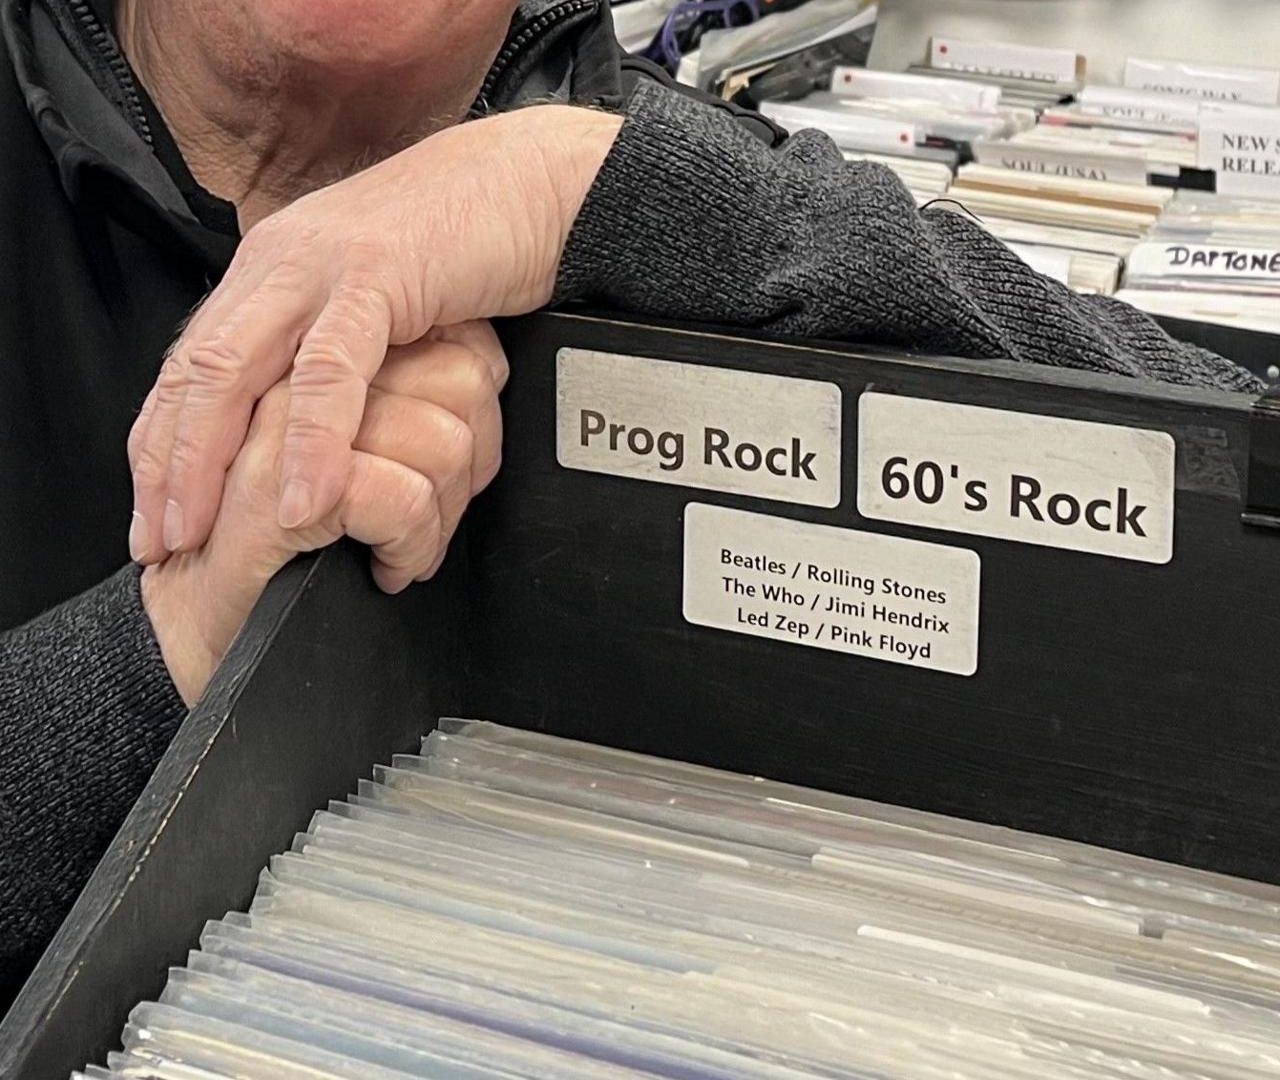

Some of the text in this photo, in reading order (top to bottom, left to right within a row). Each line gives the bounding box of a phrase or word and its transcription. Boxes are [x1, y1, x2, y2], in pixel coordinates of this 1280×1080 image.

[1222, 133, 1270, 154] NEW
[579, 409, 818, 481] Prog Rock
[881, 456, 1148, 538] 60's Rock
[721, 548, 947, 604] Beatles / Rolling Stones
[722, 576, 950, 634] The Who / Jimi Hendrix
[737, 608, 931, 660] Led Zep / Pink Floyd
